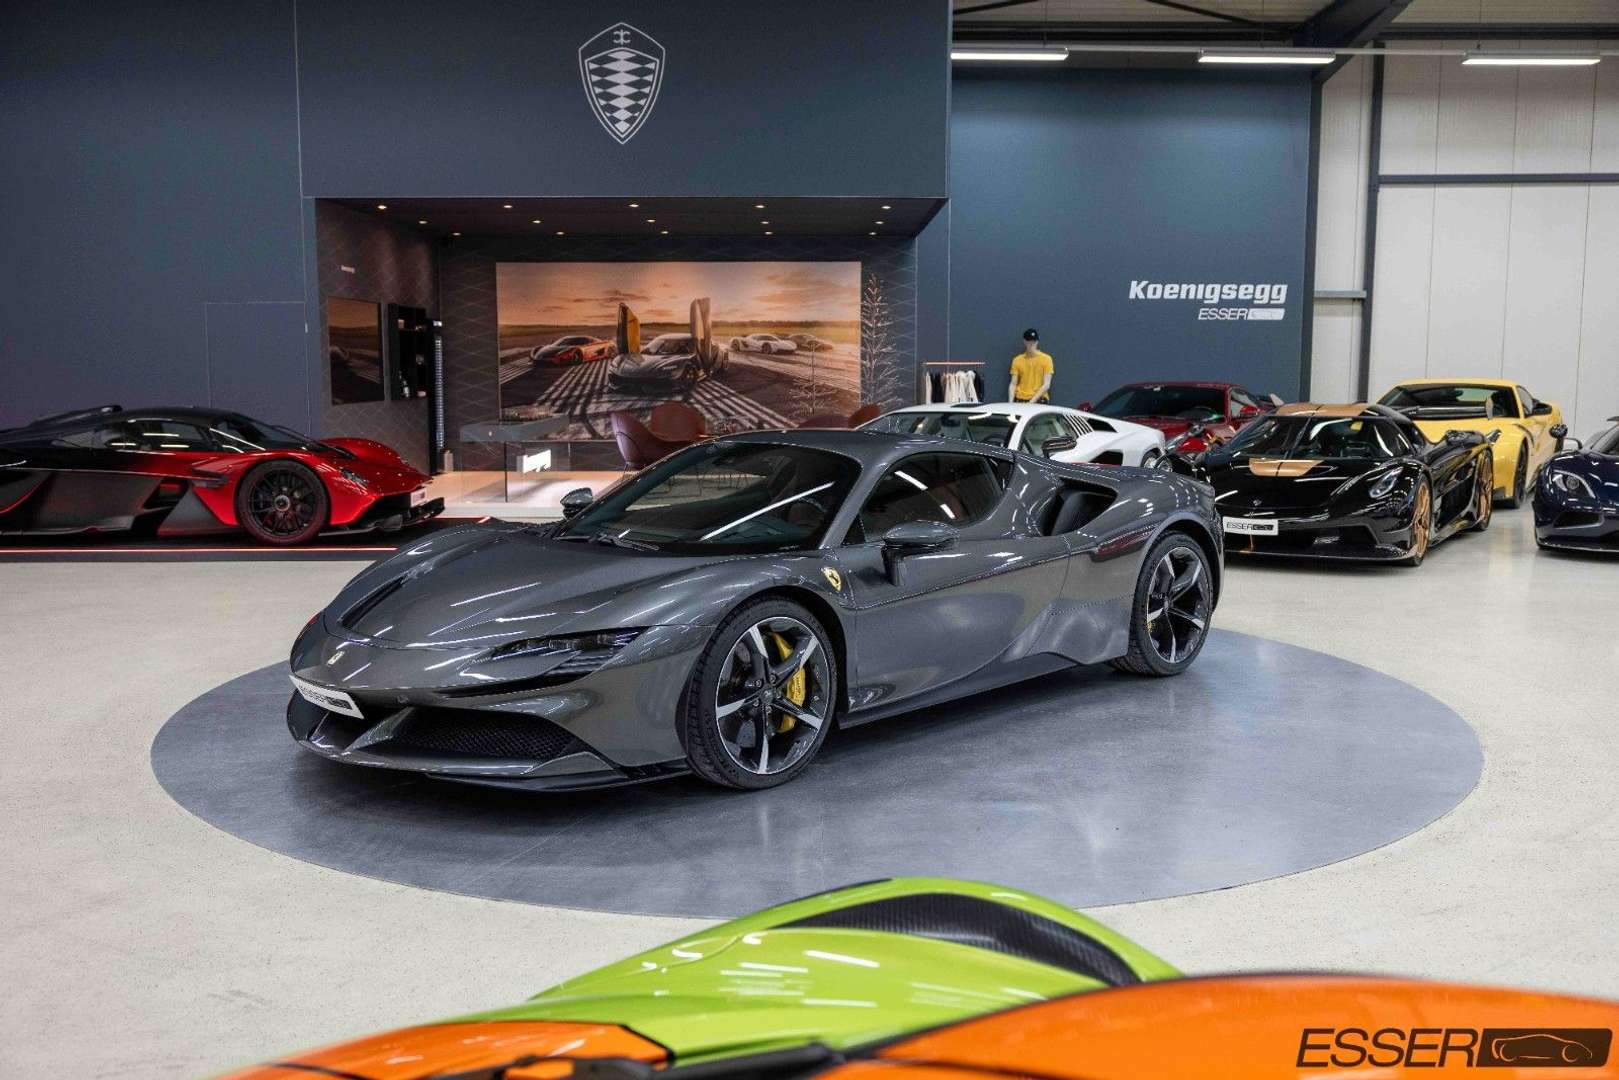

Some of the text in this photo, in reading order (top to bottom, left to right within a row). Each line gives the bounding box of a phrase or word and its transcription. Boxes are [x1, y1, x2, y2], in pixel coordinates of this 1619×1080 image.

[1129, 280, 1288, 304] Koenigsegg
[1198, 308, 1248, 320] ESSER
[1226, 521, 1253, 531] ESSER
